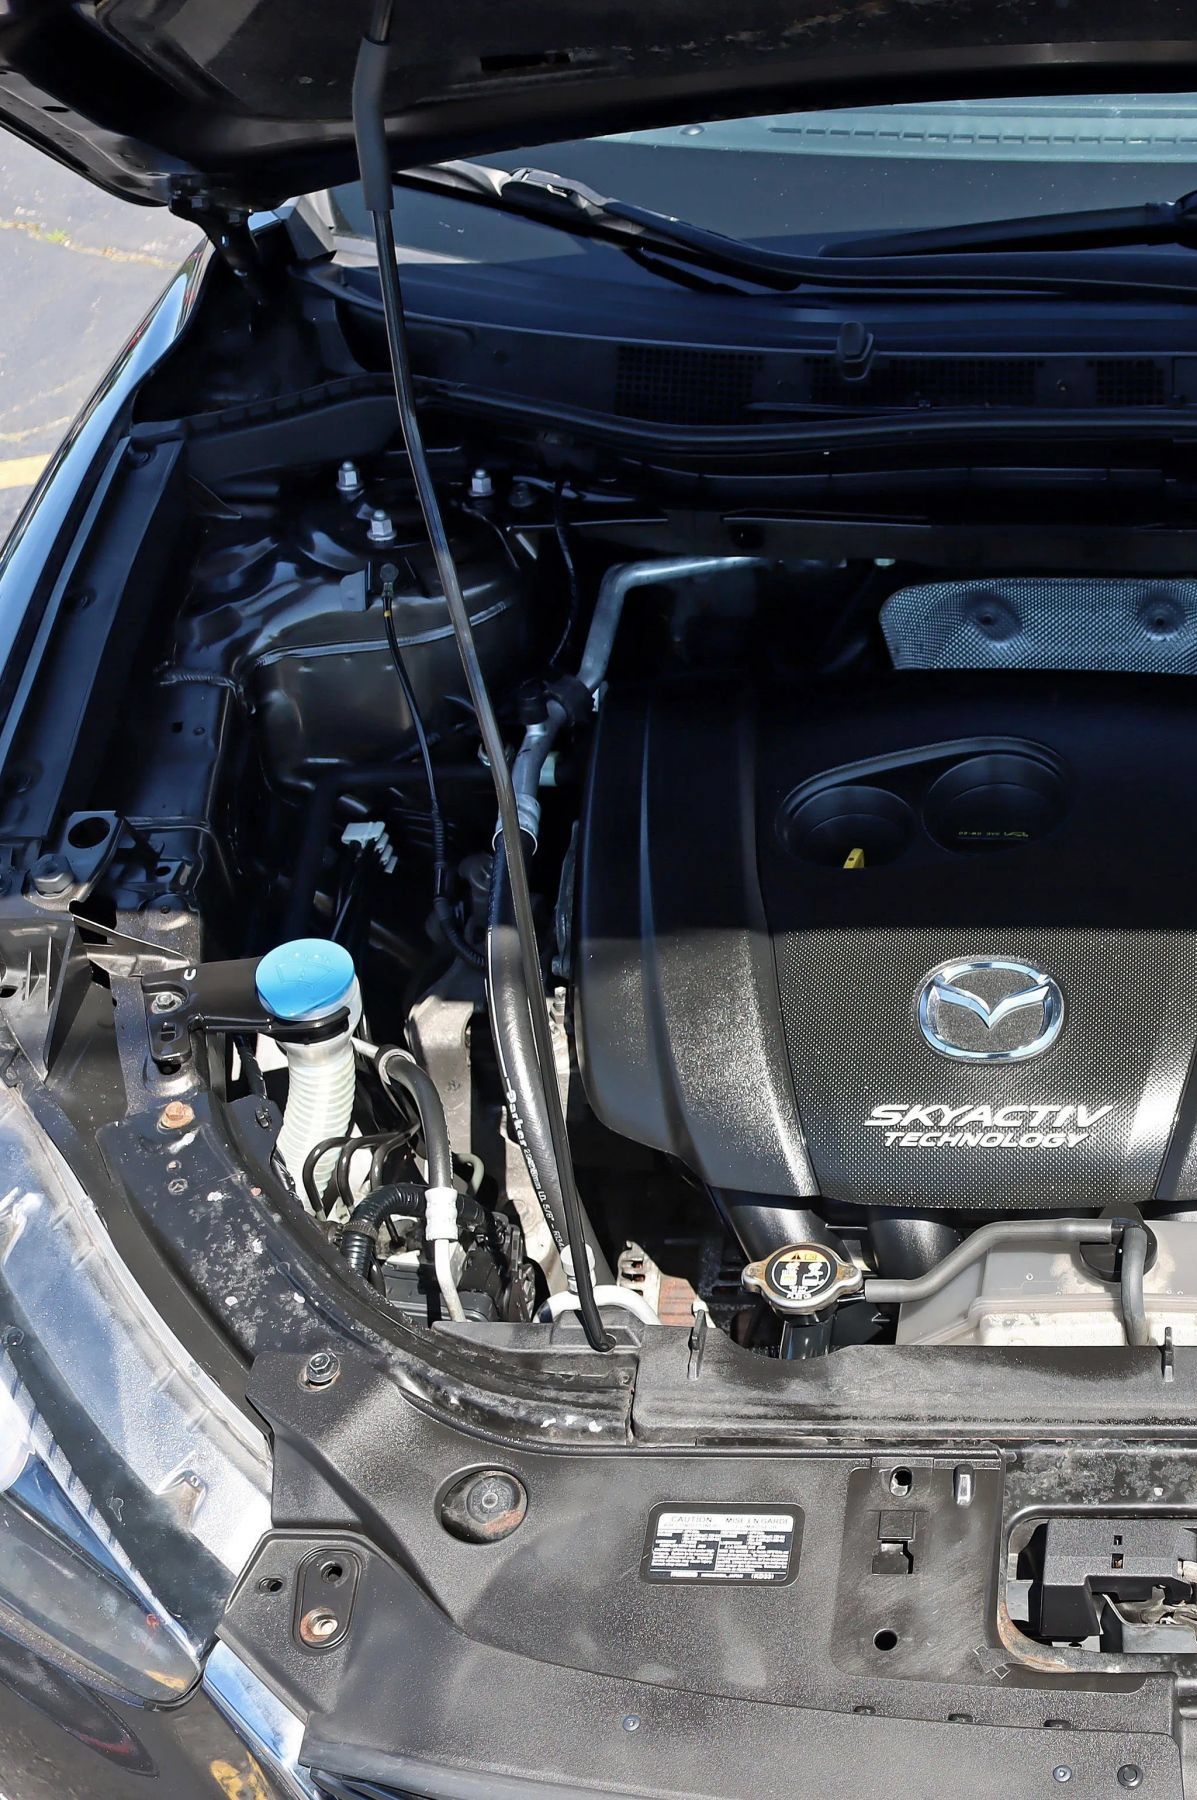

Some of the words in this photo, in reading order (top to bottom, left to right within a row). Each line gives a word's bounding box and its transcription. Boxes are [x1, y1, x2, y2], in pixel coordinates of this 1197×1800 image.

[506, 1091, 527, 1147] Parker
[864, 1103, 1114, 1128] SKYACTIV
[884, 1131, 1091, 1149] TECHNOLOGY
